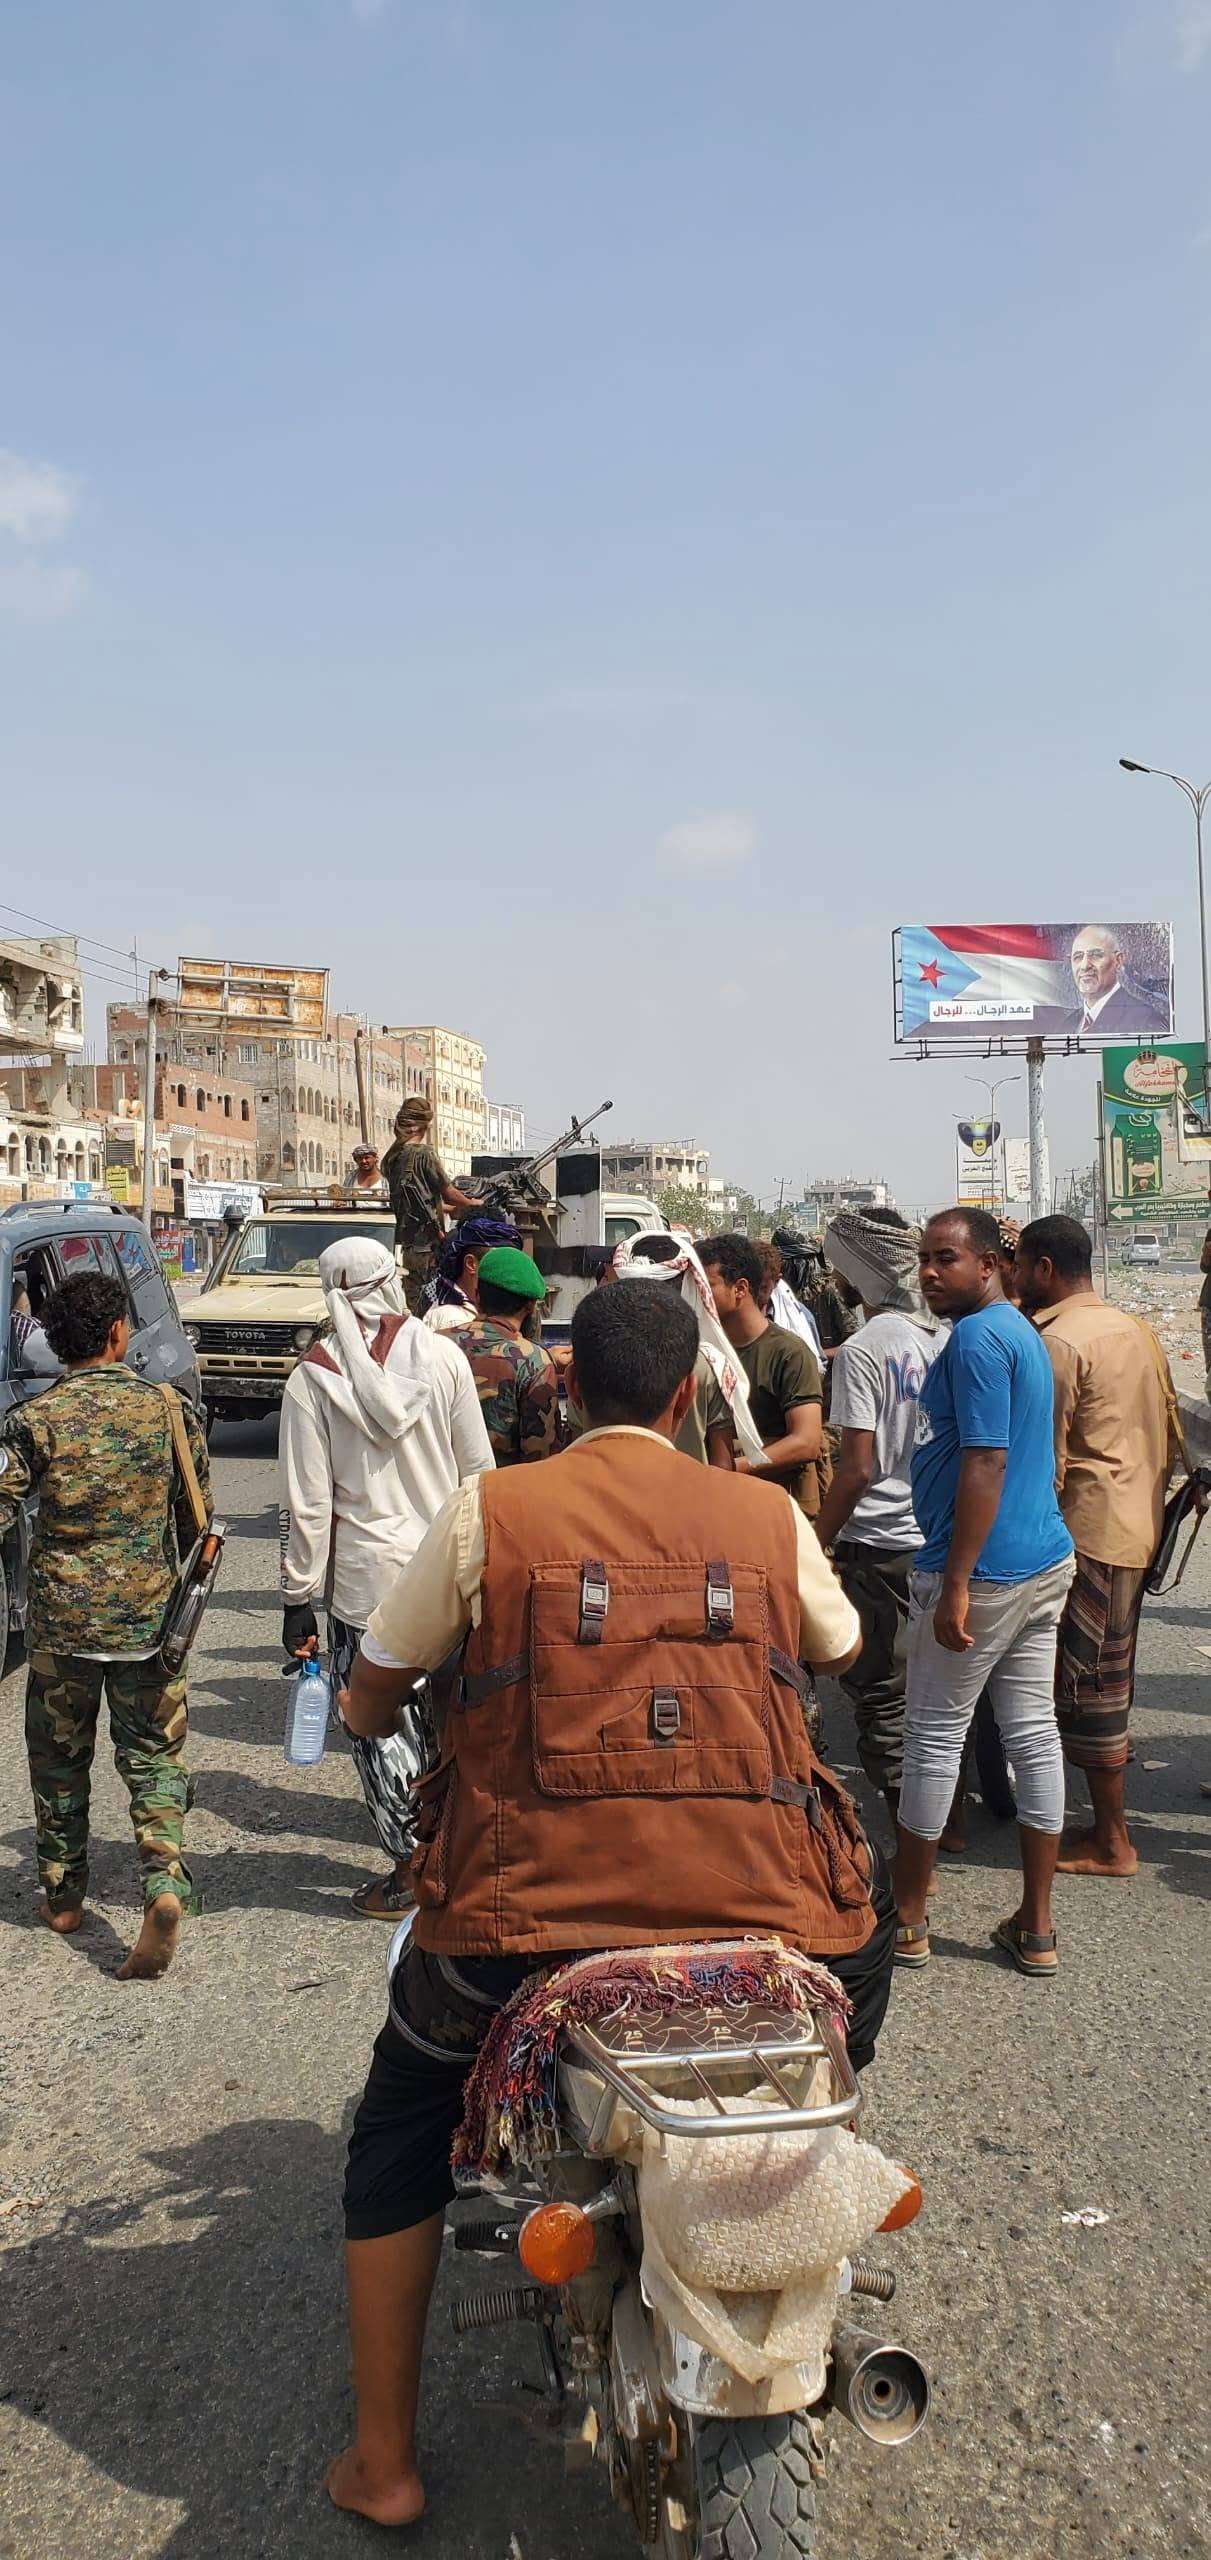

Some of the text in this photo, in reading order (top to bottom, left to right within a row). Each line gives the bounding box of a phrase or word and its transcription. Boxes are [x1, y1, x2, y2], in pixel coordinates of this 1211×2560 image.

[933, 1005, 962, 1018] للرجال
[1008, 1005, 1031, 1015] عهد
[224, 1330, 266, 1340] TOYOTA
[624, 2030, 644, 2042] 25
[711, 2026, 732, 2037] 25
